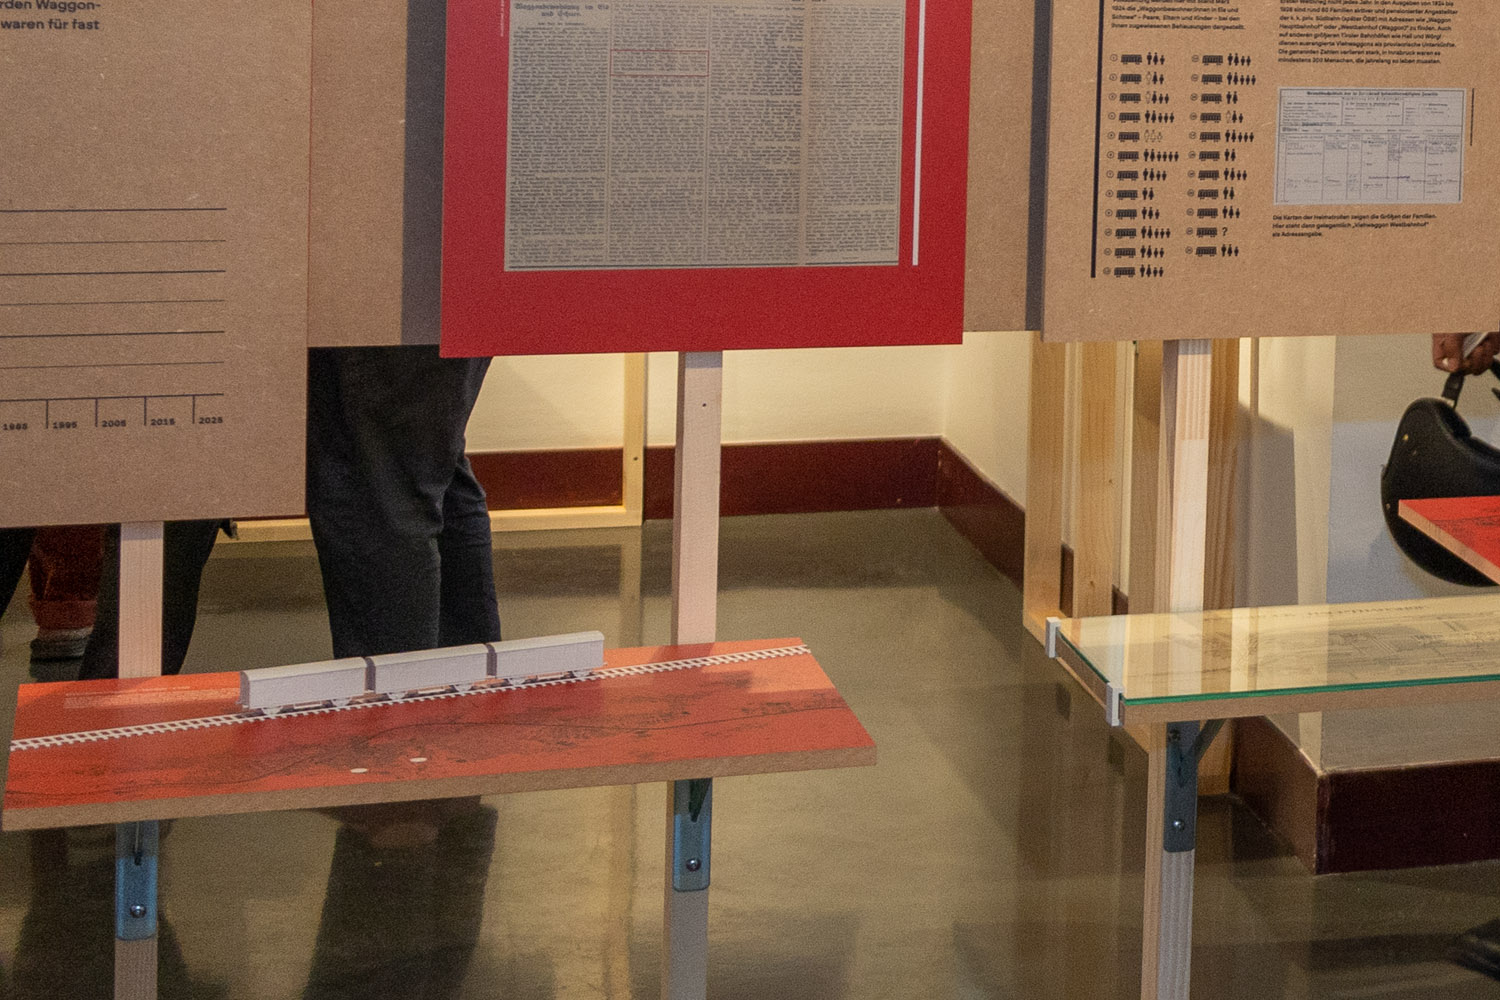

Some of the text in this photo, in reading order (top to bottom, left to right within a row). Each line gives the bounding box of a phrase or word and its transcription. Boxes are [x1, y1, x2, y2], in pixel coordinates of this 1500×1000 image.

[35, 0, 100, 13] Waggon-
[0, 18, 99, 30] waren für fast
